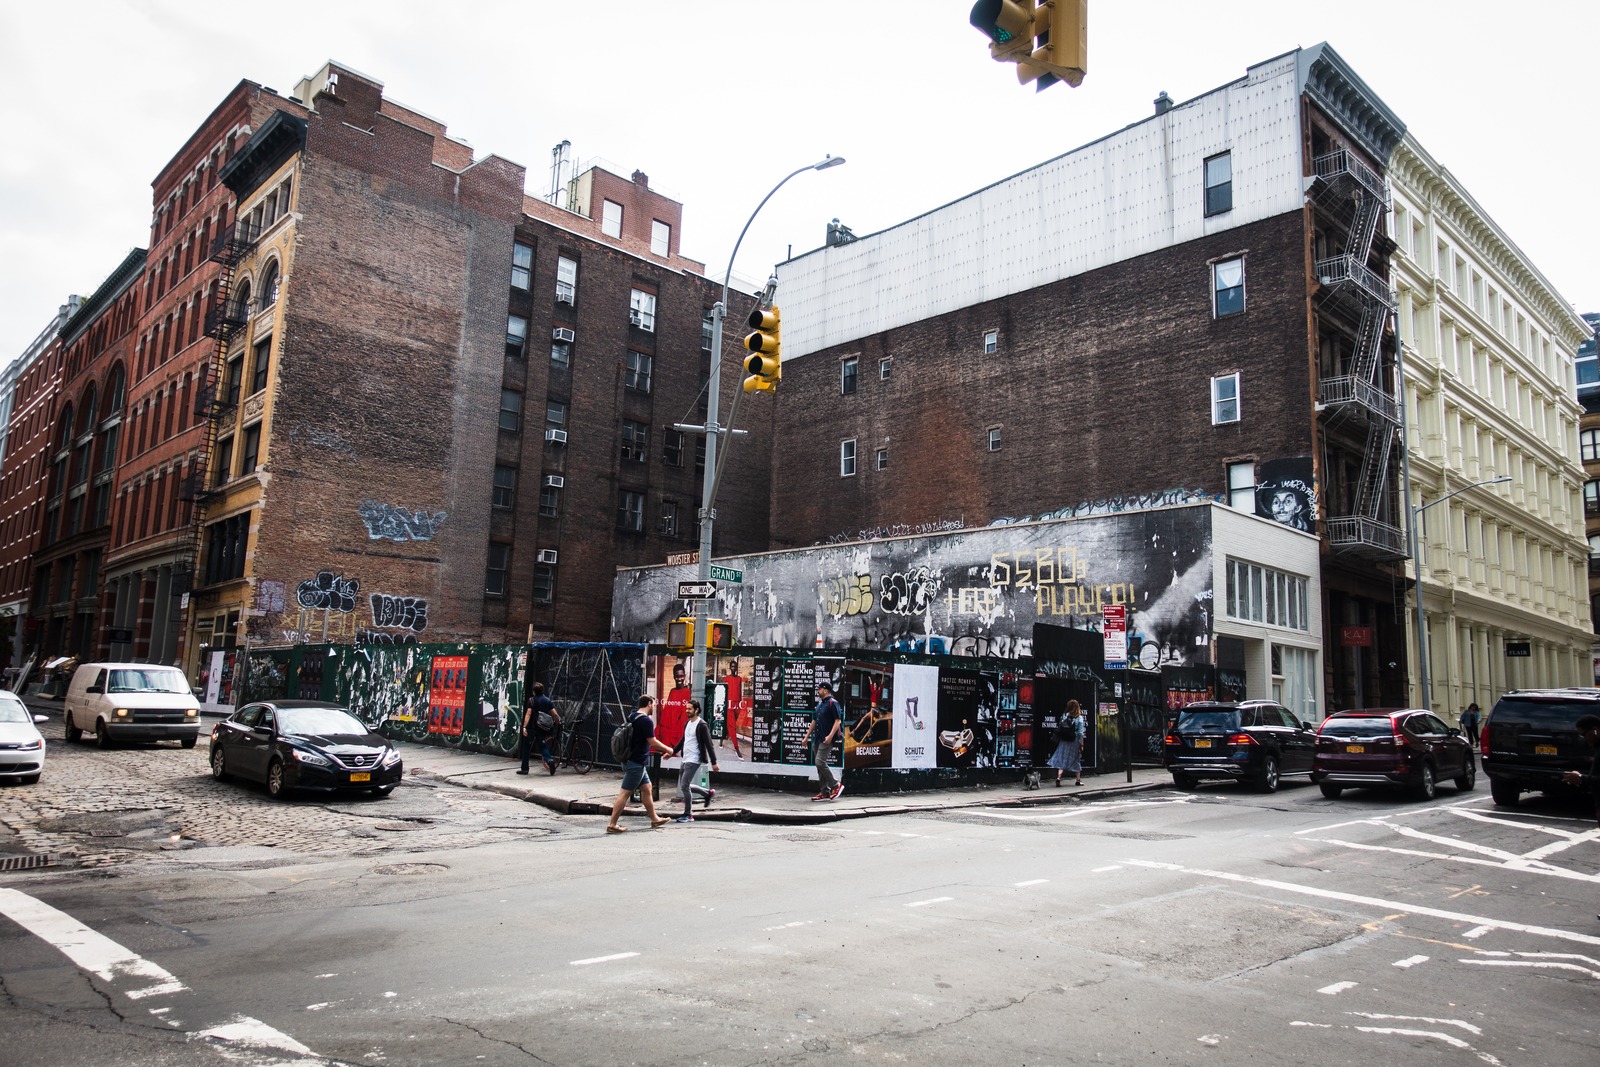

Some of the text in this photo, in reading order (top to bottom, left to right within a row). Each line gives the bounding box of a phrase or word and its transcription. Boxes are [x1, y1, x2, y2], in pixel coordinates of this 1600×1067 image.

[667, 552, 700, 566] WOOSTER ST
[711, 567, 735, 581] GRAND
[681, 586, 711, 594] ONE WAY
[1105, 631, 1110, 639] 3
[660, 698, 681, 706] Greene
[855, 746, 882, 756] BECAUSE.
[904, 746, 925, 756] SCHUTZ
